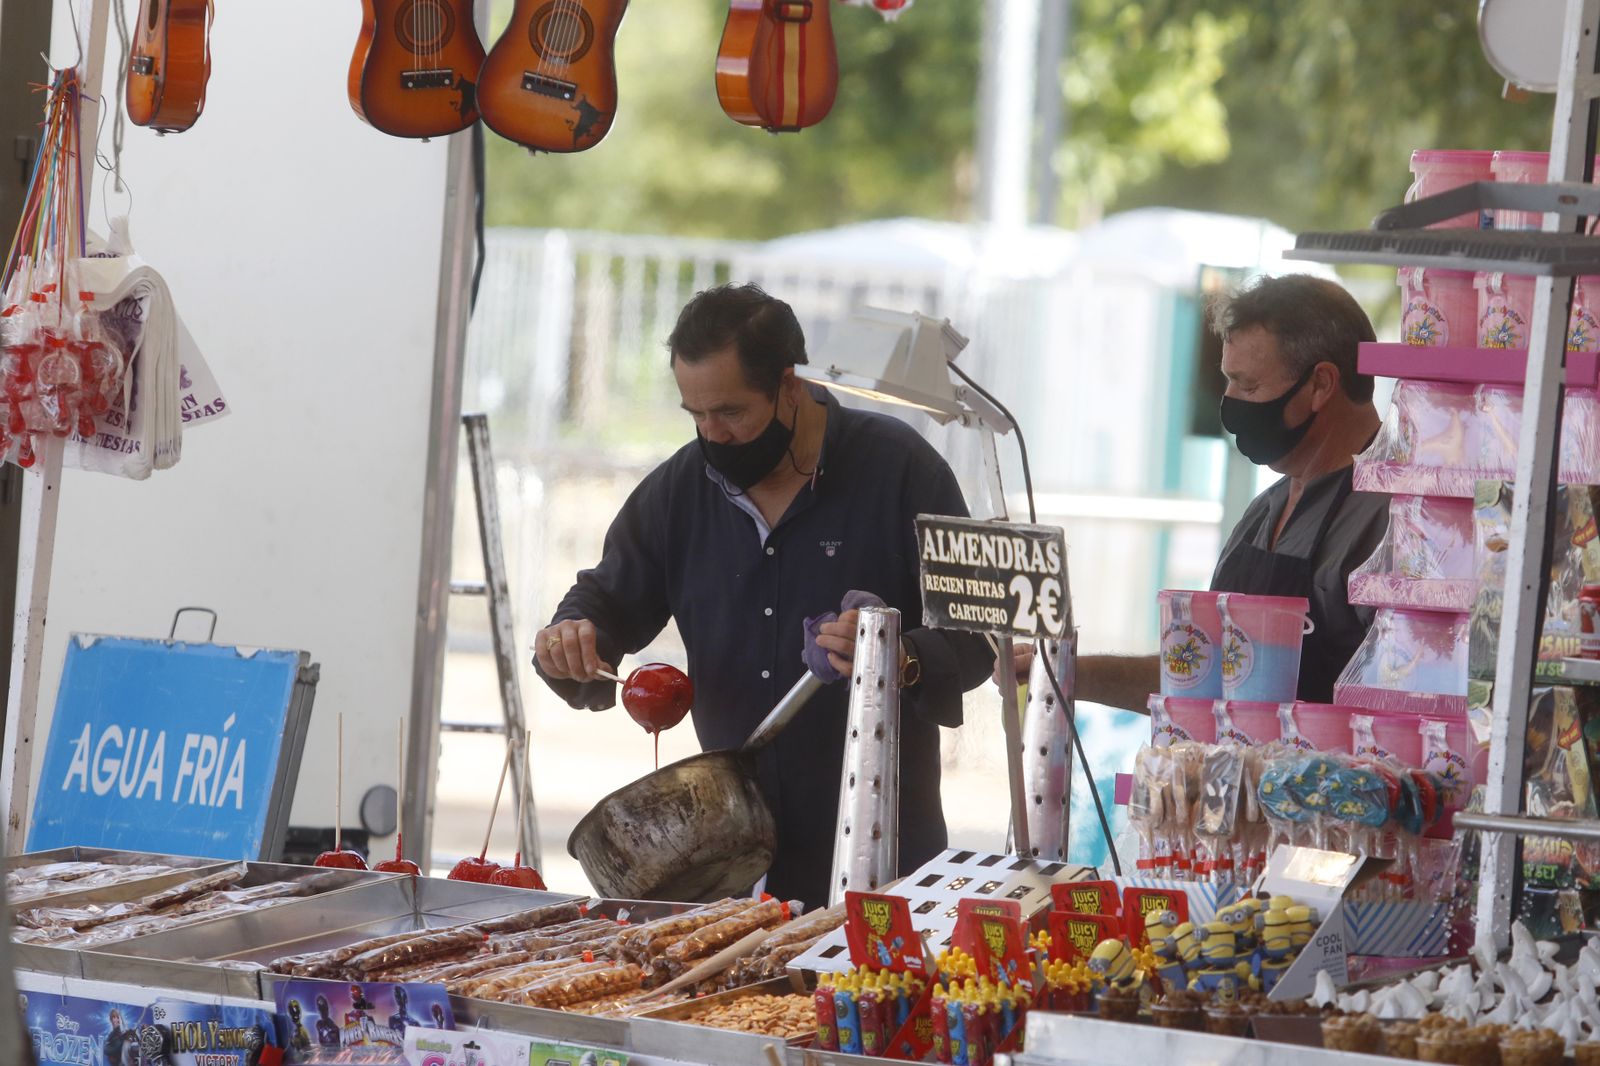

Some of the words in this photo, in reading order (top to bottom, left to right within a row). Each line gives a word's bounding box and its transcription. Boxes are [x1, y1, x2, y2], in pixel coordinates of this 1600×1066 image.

[922, 527, 1061, 575] ALMENDRAS
[925, 574, 964, 595] RECIEN
[966, 578, 1006, 600] FRITAS
[948, 602, 1008, 626] CARTUCHO
[1009, 574, 1063, 635] 2€
[62, 722, 166, 801] AGUA
[172, 711, 247, 810] FRÍA
[1071, 890, 1099, 908] JUICY
[1141, 896, 1169, 915] JUICY
[863, 901, 889, 918] JUICY
[1068, 921, 1097, 940] JUICY
[1316, 932, 1342, 947] COOL
[1323, 943, 1343, 957] FAN
[915, 1017, 932, 1031] JUIC
[29, 1025, 104, 1066] FROZEN
[170, 1021, 219, 1054] HOLY
[218, 1028, 248, 1050] SWOR
[194, 1053, 240, 1066] VICTORY
